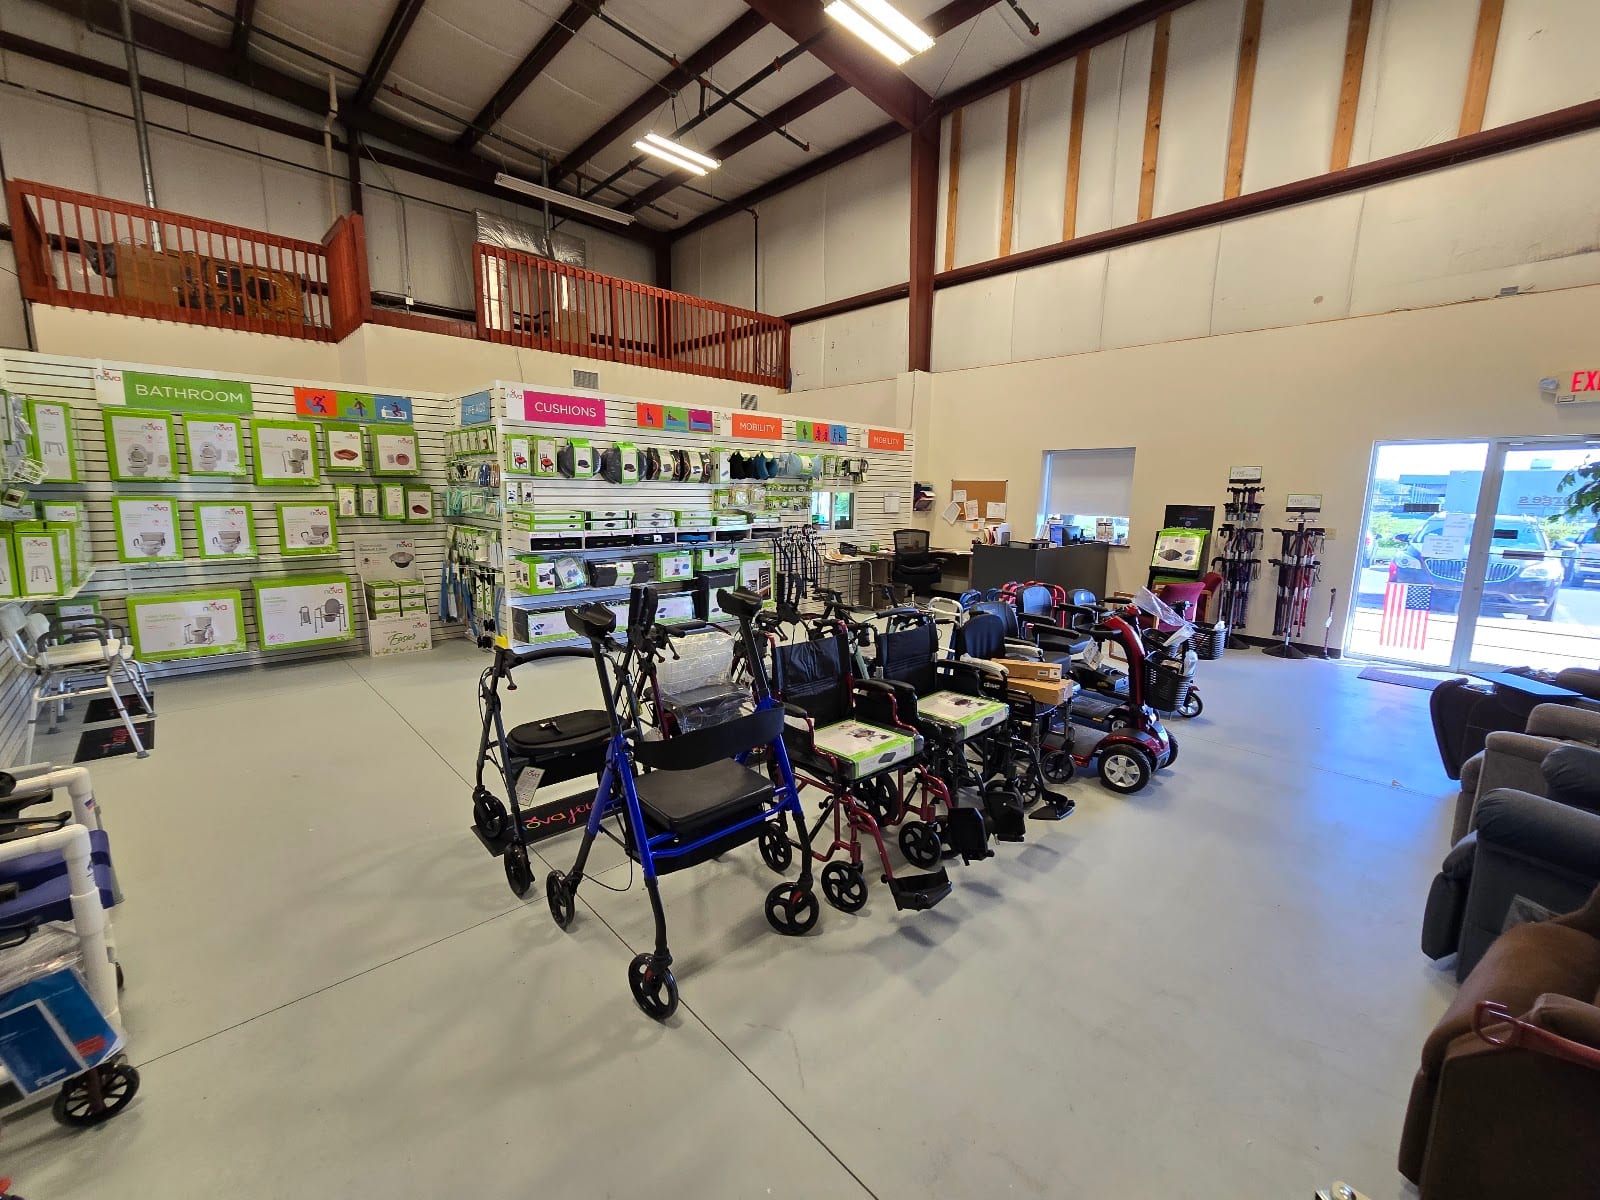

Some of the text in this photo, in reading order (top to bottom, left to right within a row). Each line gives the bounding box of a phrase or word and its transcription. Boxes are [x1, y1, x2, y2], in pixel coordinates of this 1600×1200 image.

[1571, 370, 1600, 392] EXI
[135, 384, 243, 404] BATHROOM
[534, 401, 597, 418] CUSHIONS
[739, 422, 776, 433] MOBILITY
[873, 435, 900, 446] MOBILITY
